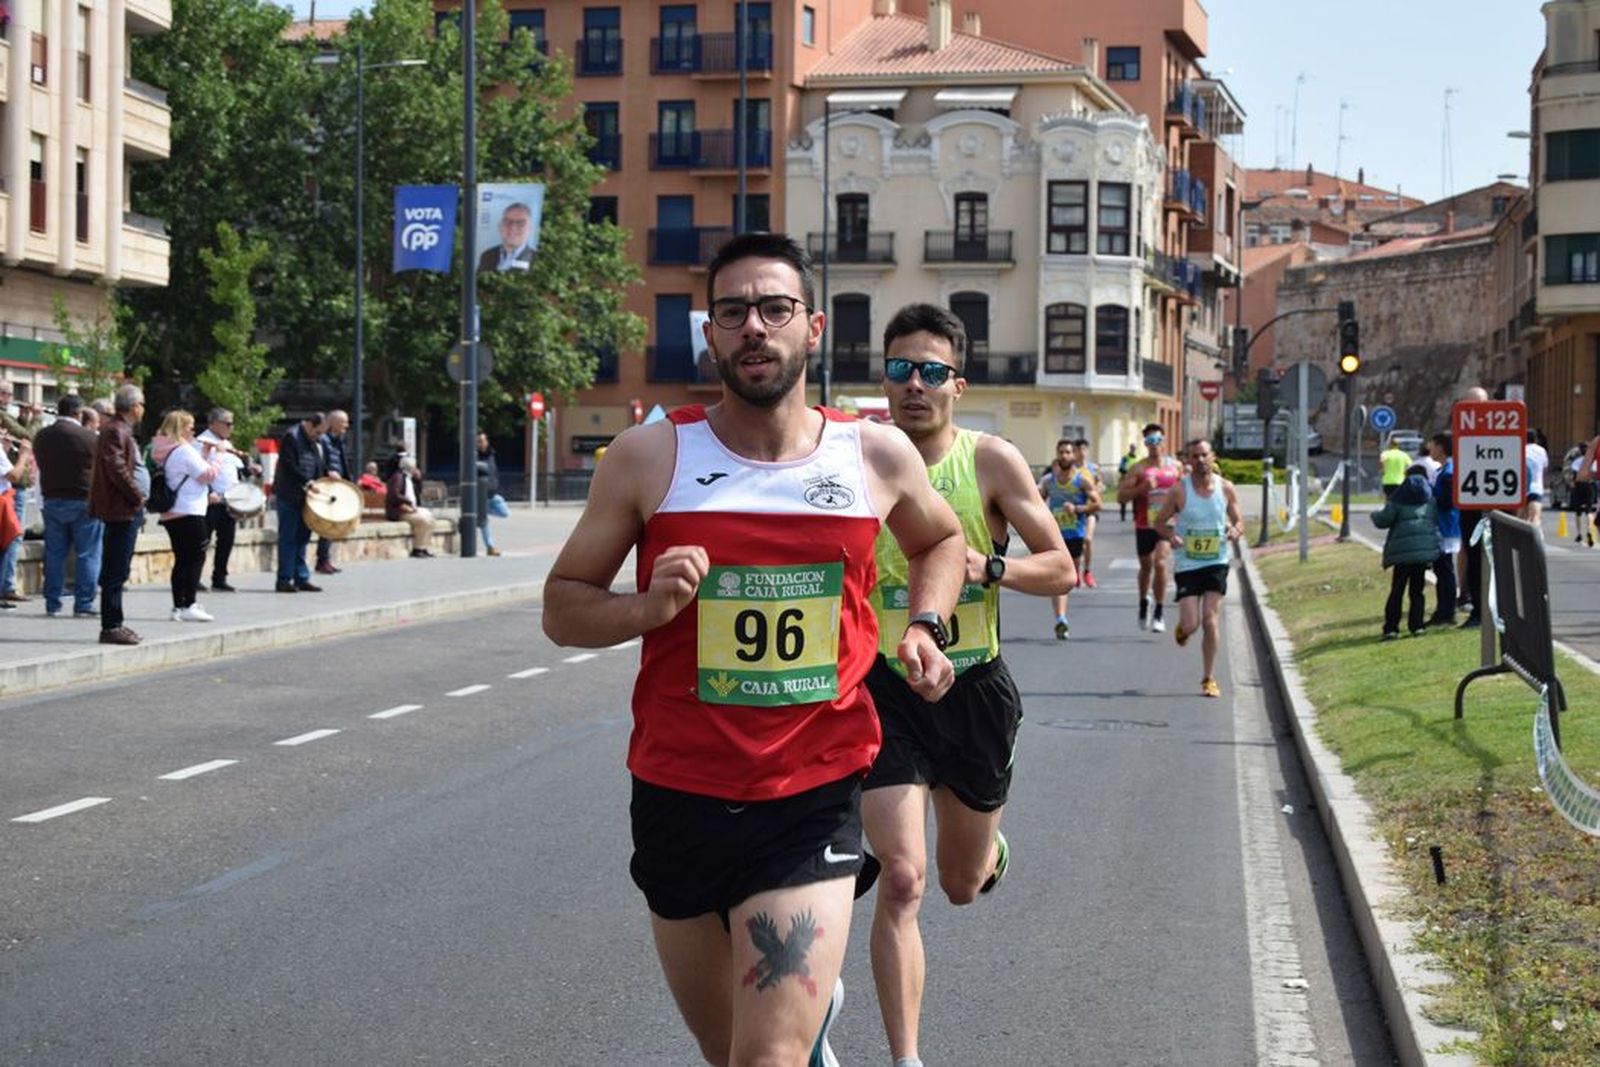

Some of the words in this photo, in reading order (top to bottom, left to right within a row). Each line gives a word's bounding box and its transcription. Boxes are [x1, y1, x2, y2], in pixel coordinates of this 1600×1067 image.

[404, 207, 443, 221] VOTA
[1459, 410, 1520, 430] N-122
[1475, 444, 1504, 460] km
[1461, 468, 1519, 497] 459
[1194, 538, 1212, 551] 67
[744, 570, 826, 586] FUNDACION
[744, 585, 779, 598] CAJA
[781, 583, 824, 597] RURAL
[734, 608, 805, 662] 96
[740, 681, 779, 695] CAJA
[783, 676, 830, 693] RURAL
